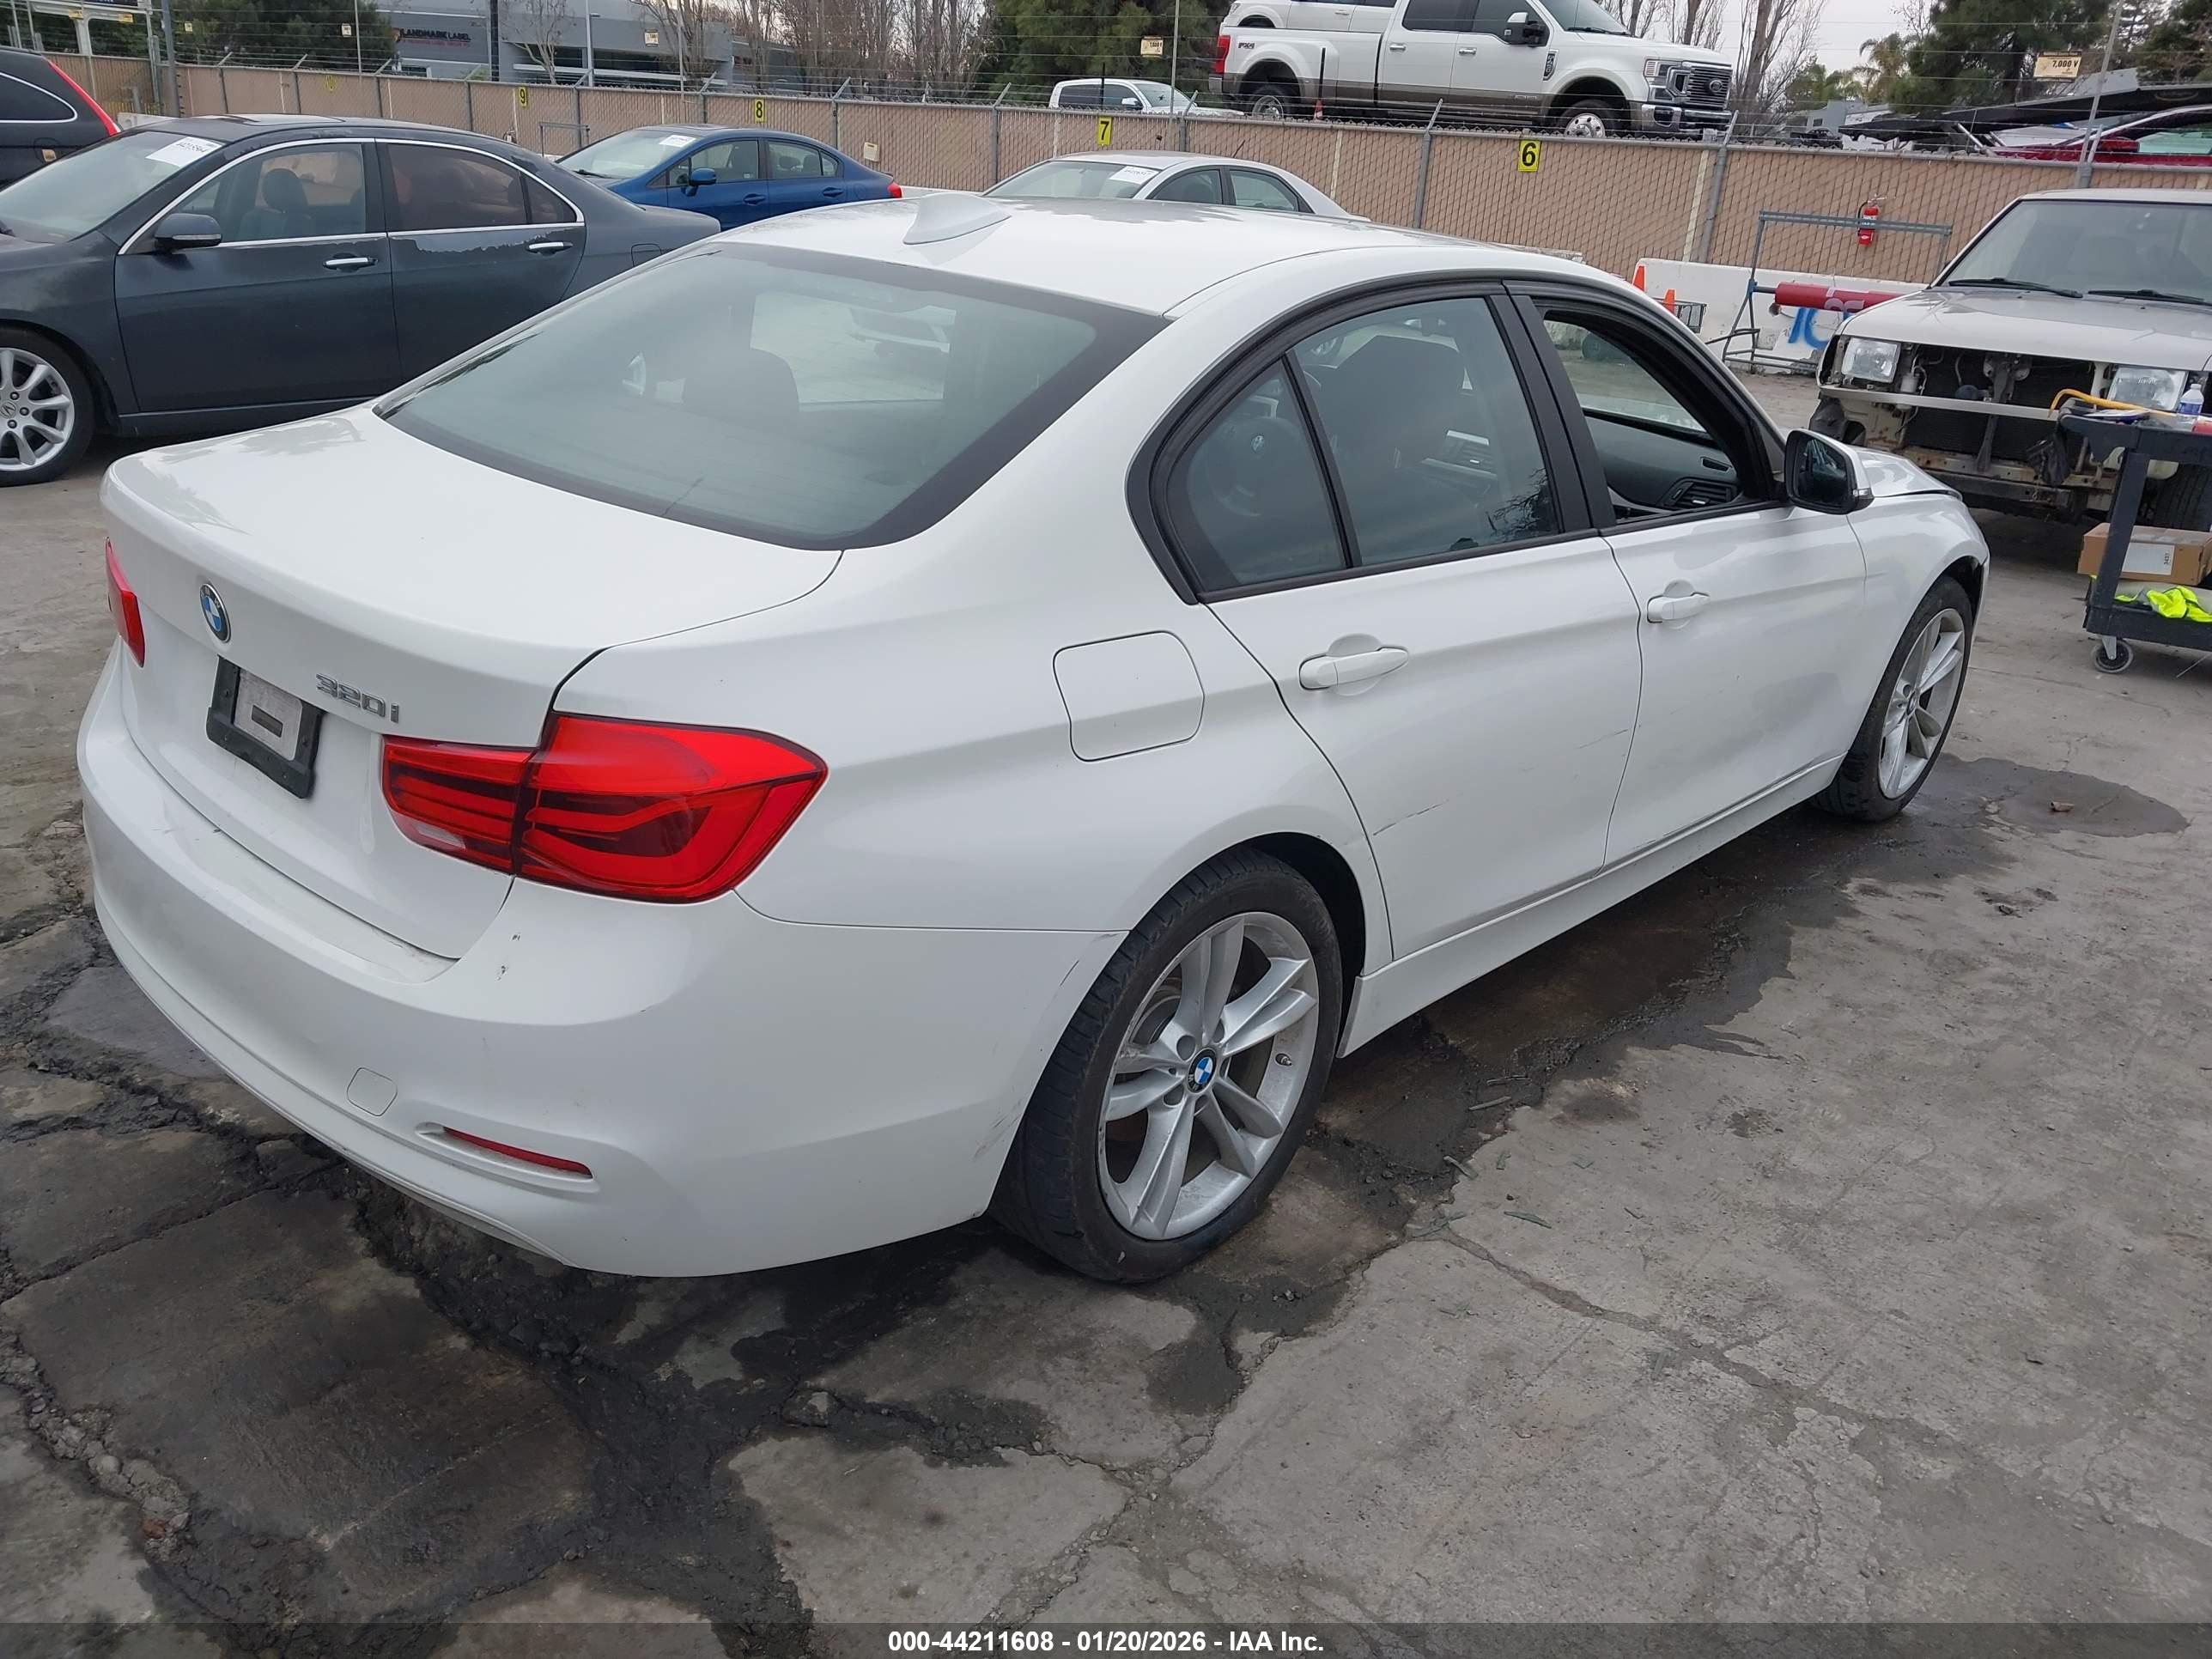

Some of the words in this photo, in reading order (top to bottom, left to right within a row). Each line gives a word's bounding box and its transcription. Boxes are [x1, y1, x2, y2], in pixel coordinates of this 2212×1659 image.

[520, 88, 526, 104] 9
[756, 100, 763, 118] 8
[1100, 120, 1109, 141] 7
[1522, 142, 1537, 167] 6
